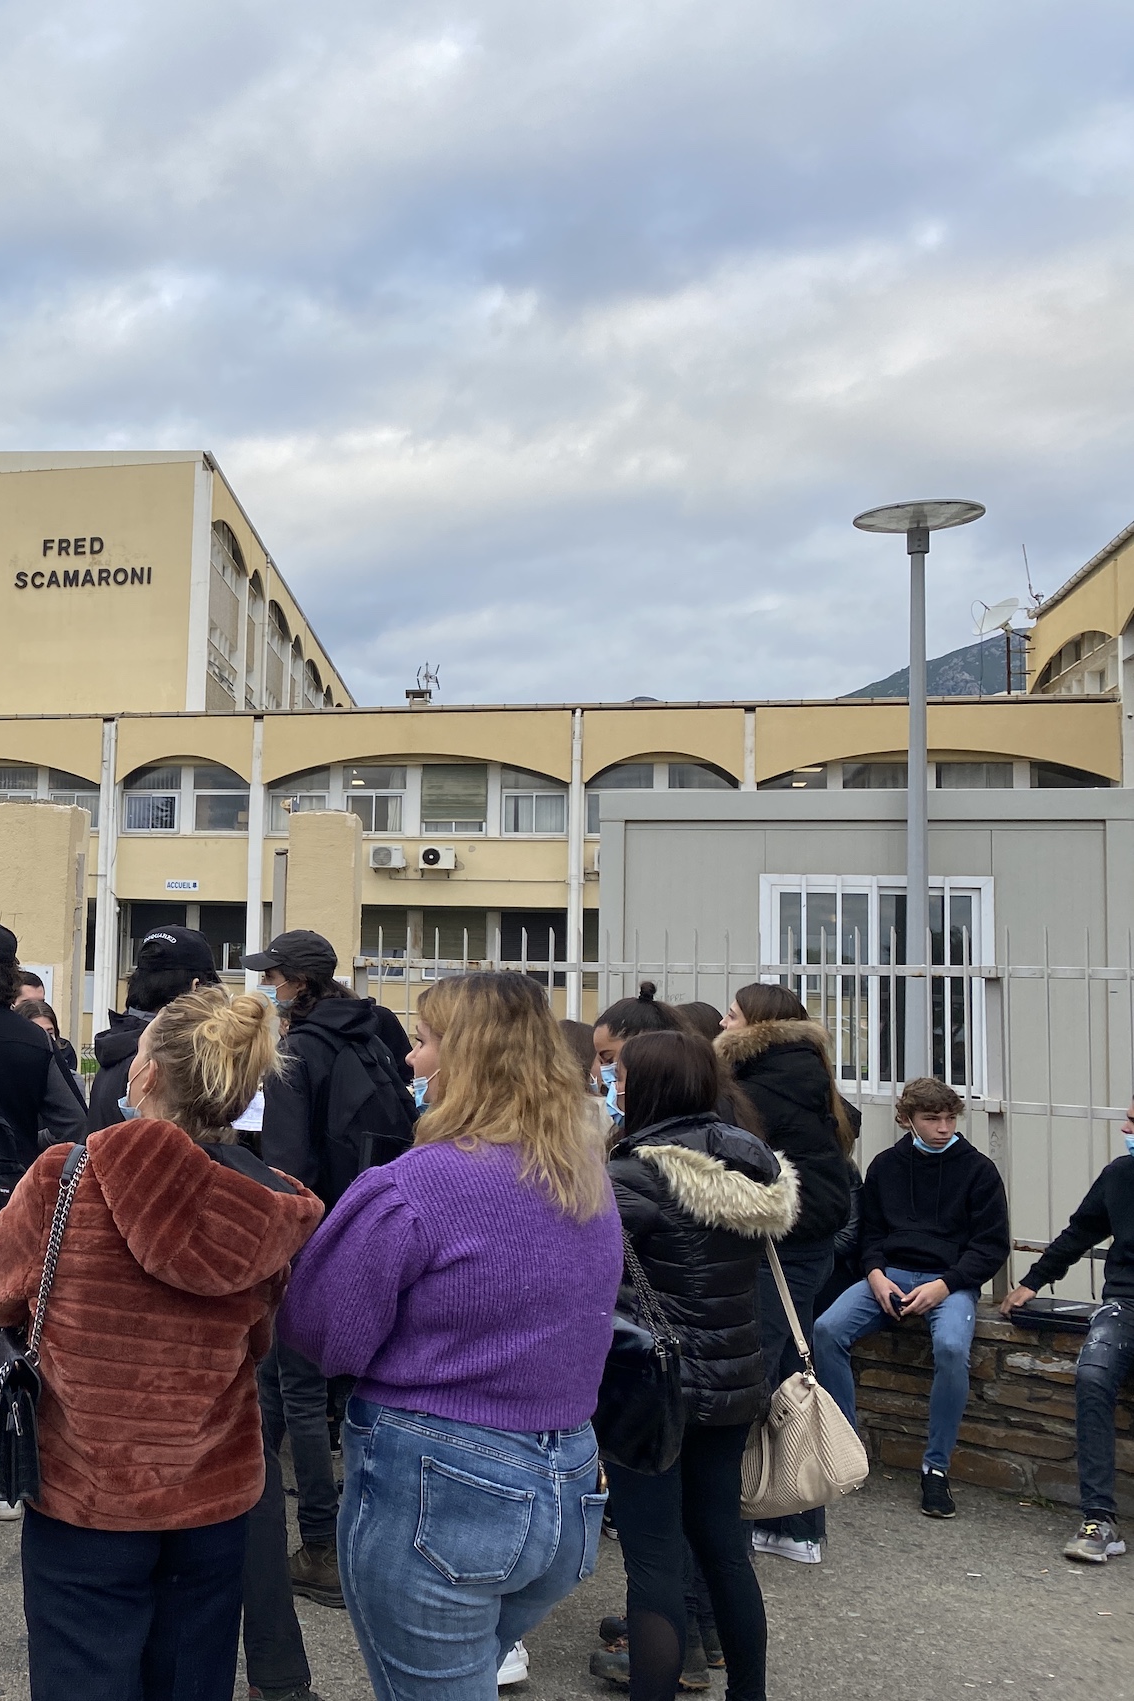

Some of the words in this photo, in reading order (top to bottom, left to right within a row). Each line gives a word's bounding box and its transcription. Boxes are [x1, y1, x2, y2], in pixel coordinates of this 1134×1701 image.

[42, 536, 104, 556] FRED
[14, 566, 152, 589] SCAMARONI
[166, 881, 192, 889] ACCUEIL
